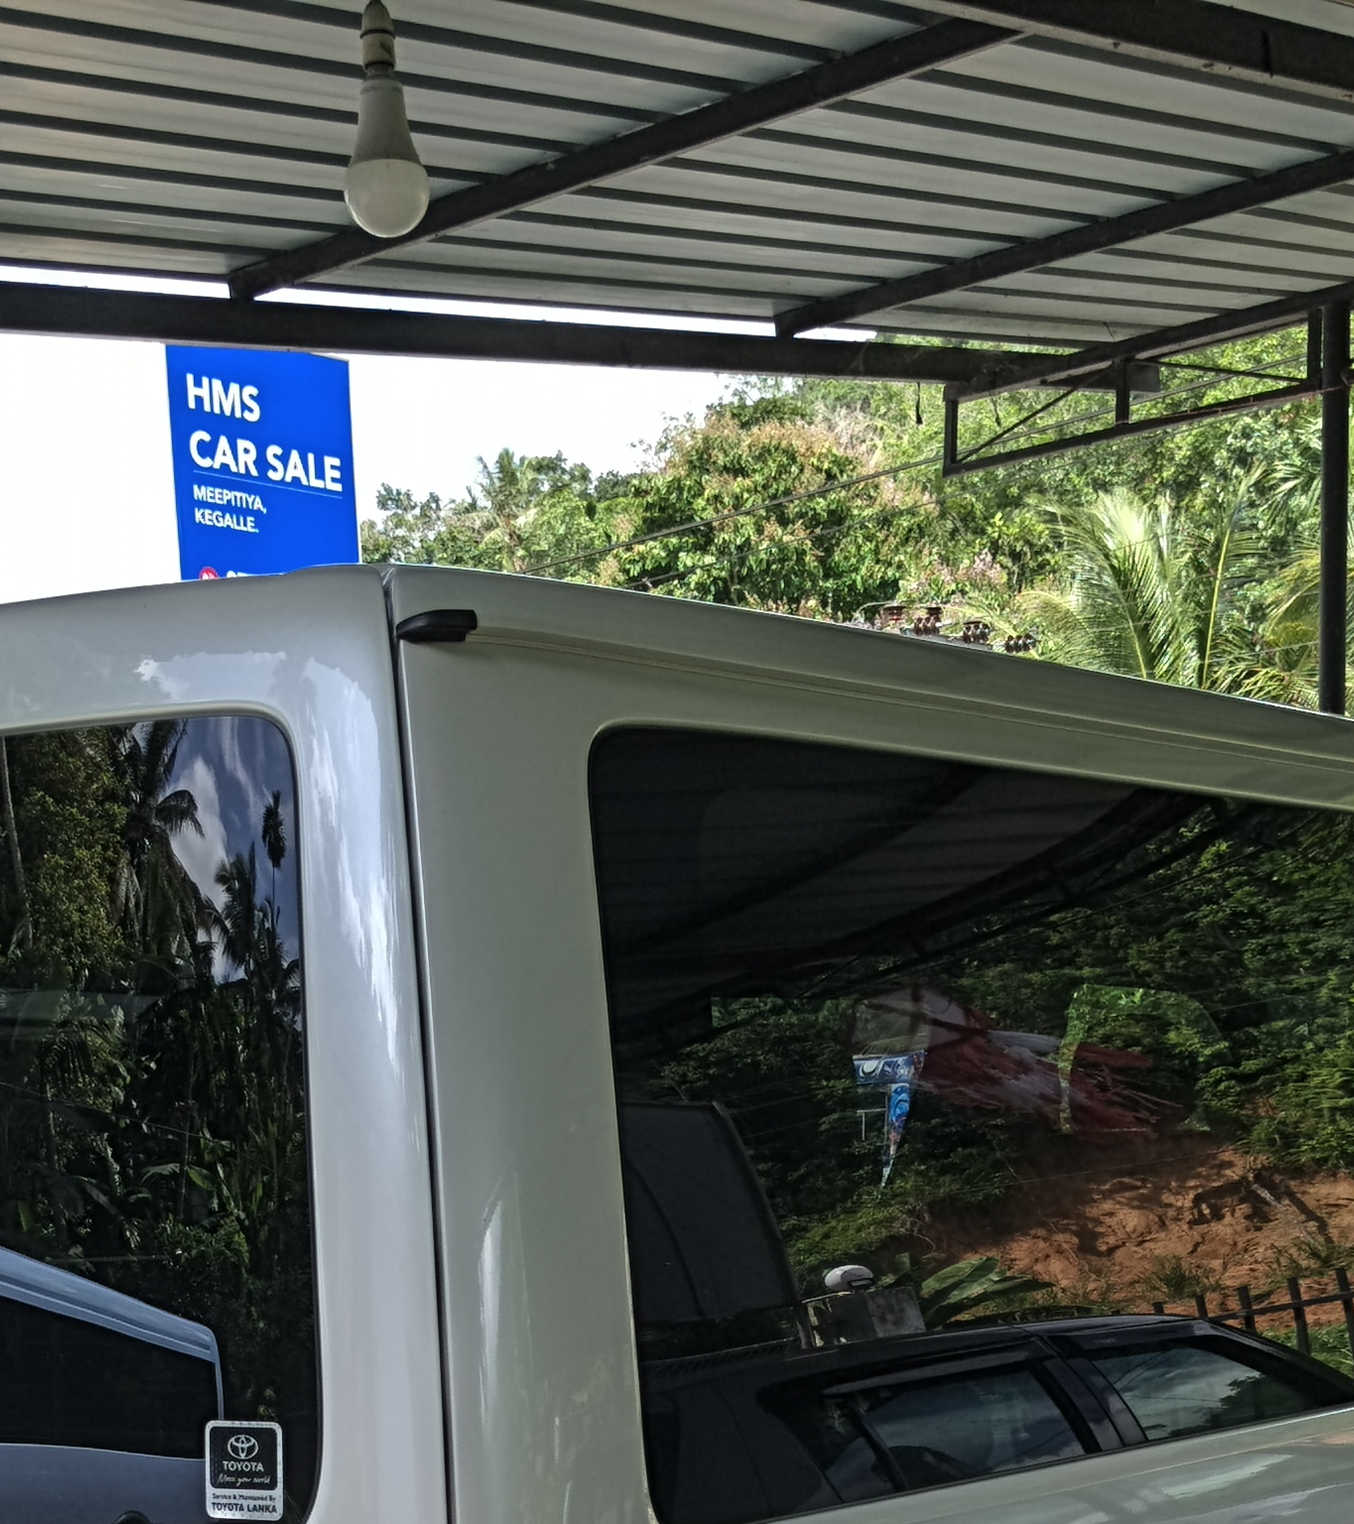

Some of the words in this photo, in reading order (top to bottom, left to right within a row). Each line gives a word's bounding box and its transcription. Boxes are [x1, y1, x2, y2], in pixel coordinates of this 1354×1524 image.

[186, 372, 261, 422] HMS
[189, 430, 259, 477] CAR
[266, 444, 343, 492] SALE
[195, 507, 259, 533] KEGALLE.
[222, 1461, 264, 1472] TOYOTA
[211, 1502, 245, 1512] TOYOTA
[247, 1503, 278, 1514] LANKA
